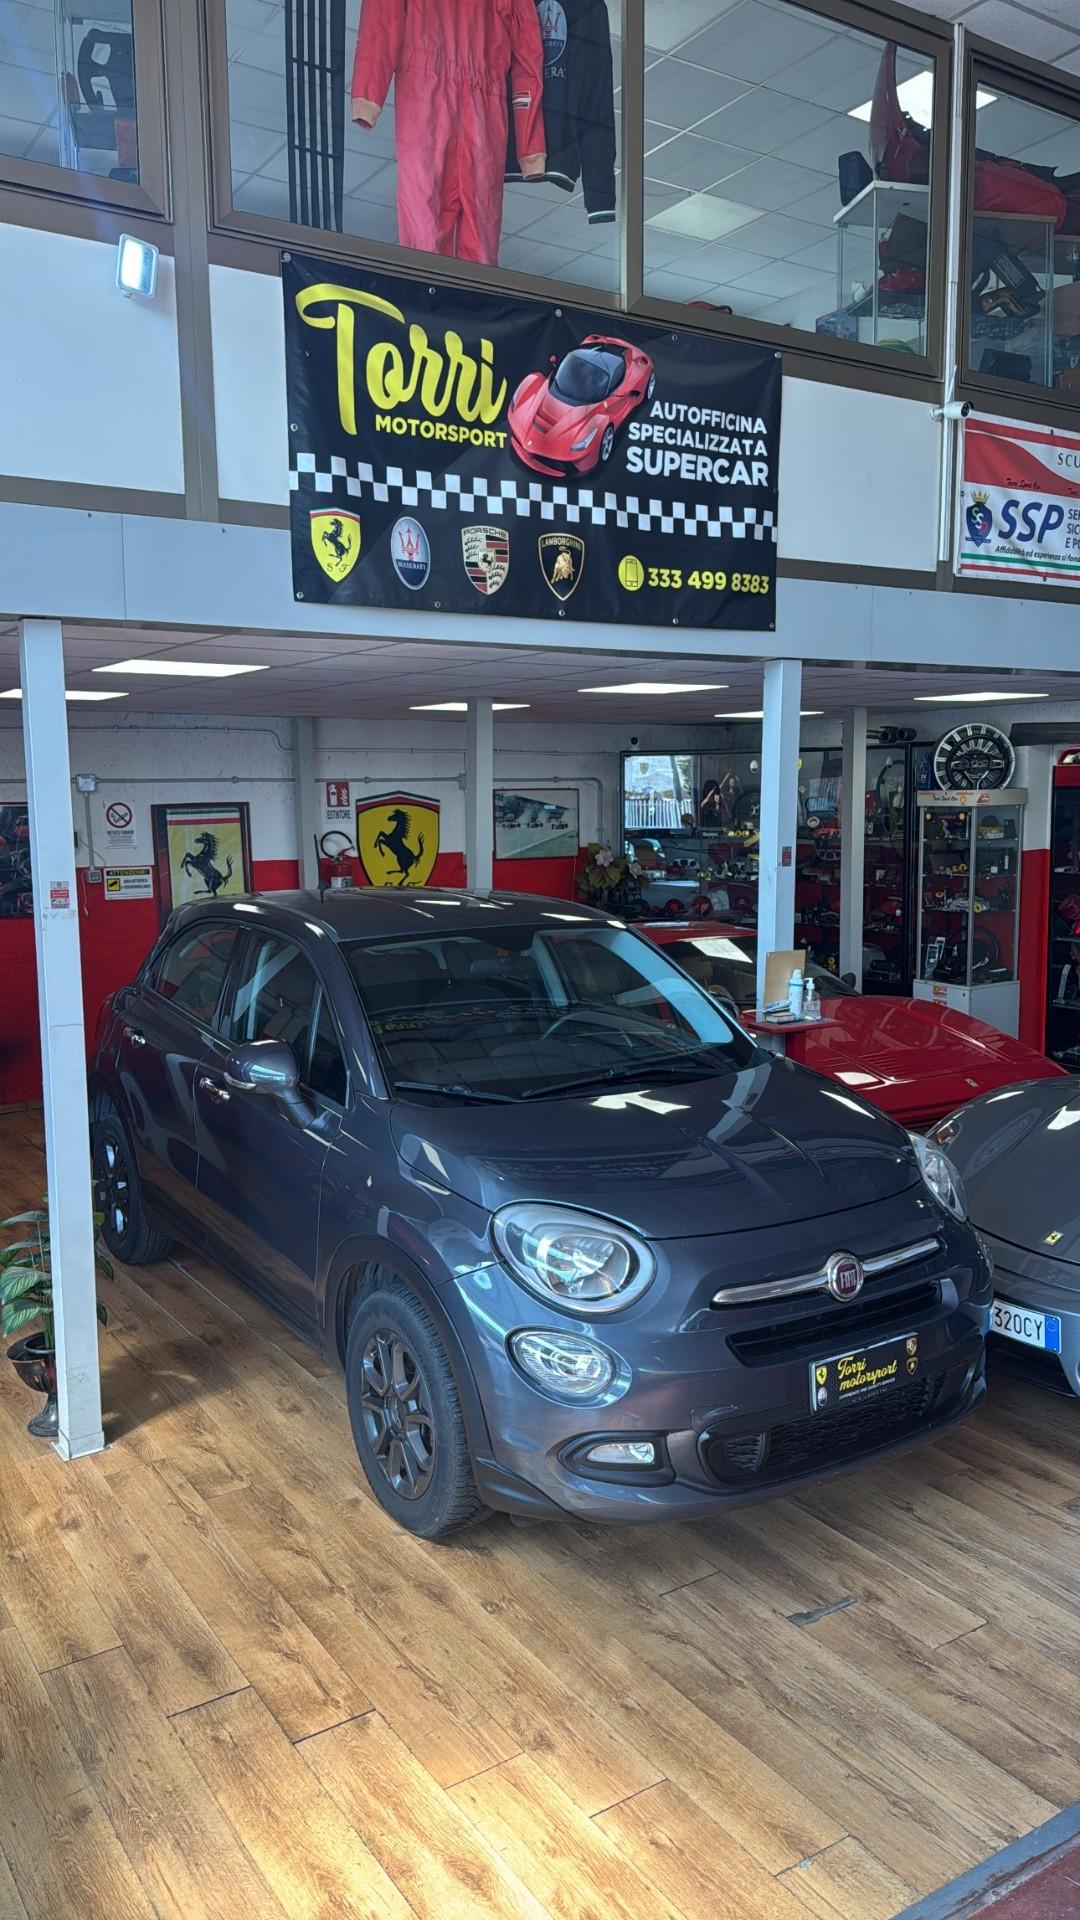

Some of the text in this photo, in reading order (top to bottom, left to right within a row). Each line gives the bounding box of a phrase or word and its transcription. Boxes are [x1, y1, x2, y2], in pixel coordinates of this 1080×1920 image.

[295, 283, 508, 435] Torri
[375, 414, 508, 449] MOTORSPORT
[650, 400, 768, 434] AUTOFFICINA
[628, 422, 768, 457] SPECIALIZZATA
[626, 445, 769, 487] SUPERCAR
[463, 527, 507, 537] PORSCHE
[998, 499, 1065, 544] SSP
[542, 537, 581, 550] LAMBORGHINI
[1065, 537, 1071, 549] E
[398, 561, 426, 571] MASERATI
[648, 567, 770, 594] 333 499 8383
[840, 1269, 857, 1289] FIAT
[994, 1306, 1043, 1341] 320CY
[837, 1356, 867, 1379] Torri
[839, 1359, 898, 1391] motorsport
